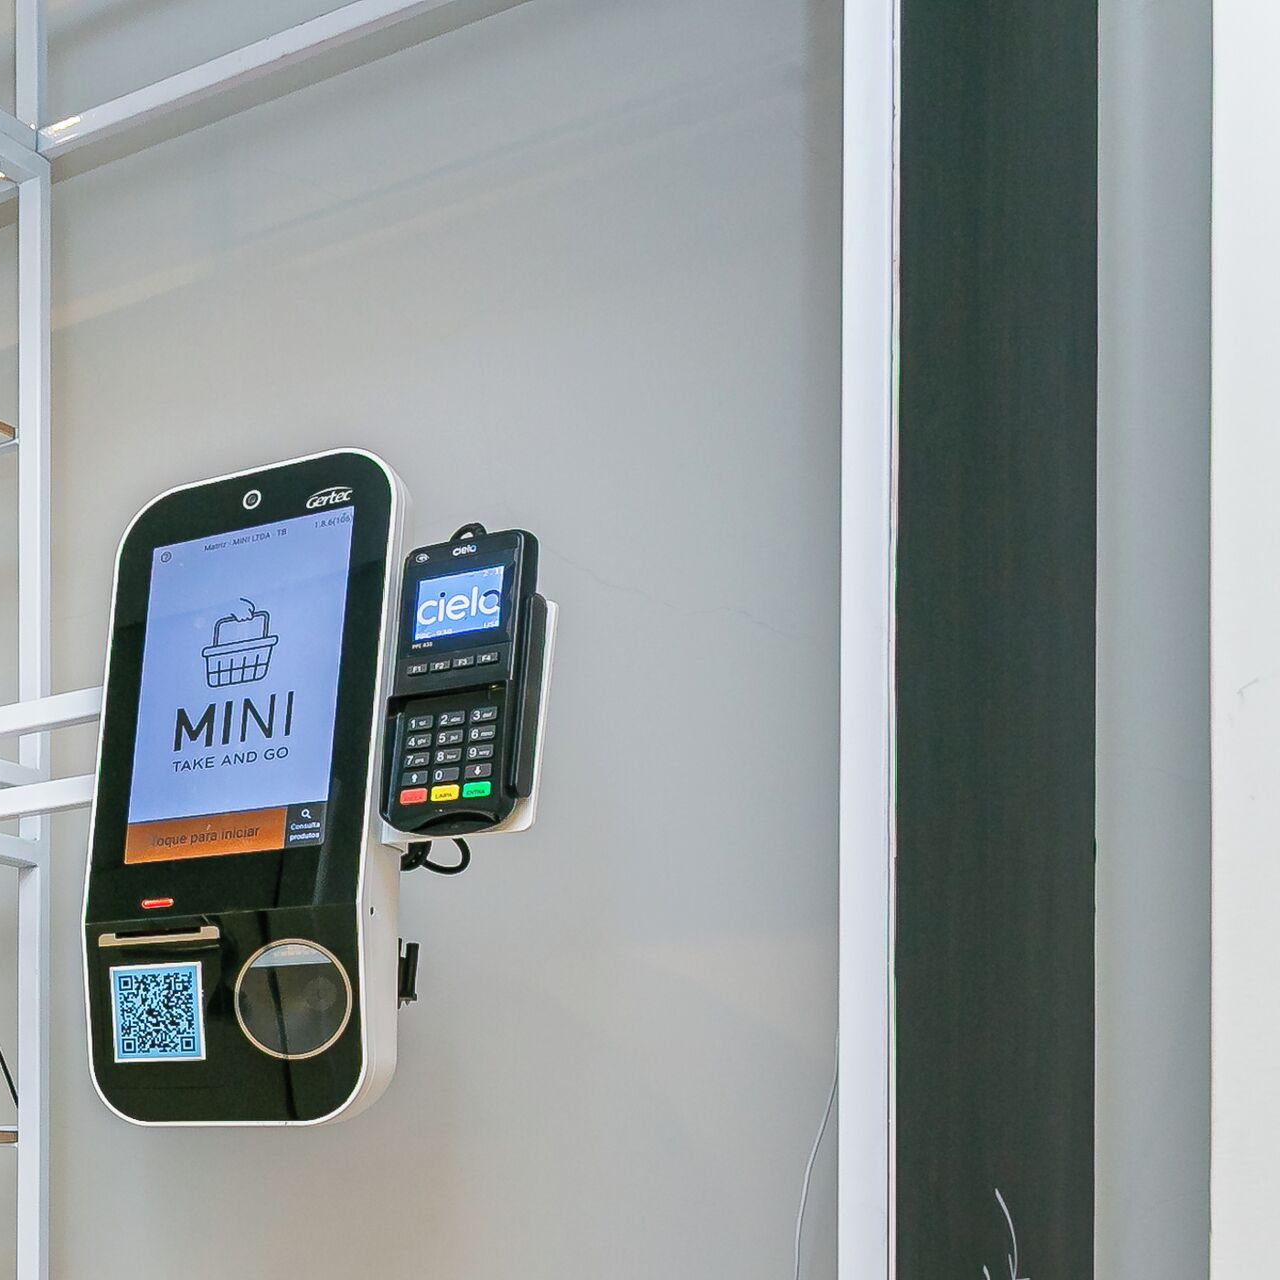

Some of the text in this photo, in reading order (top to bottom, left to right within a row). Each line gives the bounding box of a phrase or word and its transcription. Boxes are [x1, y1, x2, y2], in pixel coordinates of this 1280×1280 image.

[306, 486, 354, 509] Gertec
[251, 532, 270, 542] LTDA
[417, 586, 501, 625] cielo
[481, 654, 491, 662] F4
[413, 666, 422, 674] F1
[440, 715, 448, 725] 2
[473, 710, 480, 720] 3
[173, 691, 294, 752] MINI
[410, 719, 416, 728] 1
[438, 733, 446, 743] 5
[471, 729, 479, 739] 6
[408, 737, 415, 746] 4
[437, 751, 444, 761] 8
[469, 747, 477, 758] 9
[172, 746, 289, 773] TAKE AND GO
[406, 756, 414, 765] 7
[435, 770, 443, 780] 0
[290, 821, 320, 831] Consulta
[190, 830, 218, 845] para
[221, 825, 260, 841] iniciar
[289, 832, 320, 842] produtos
